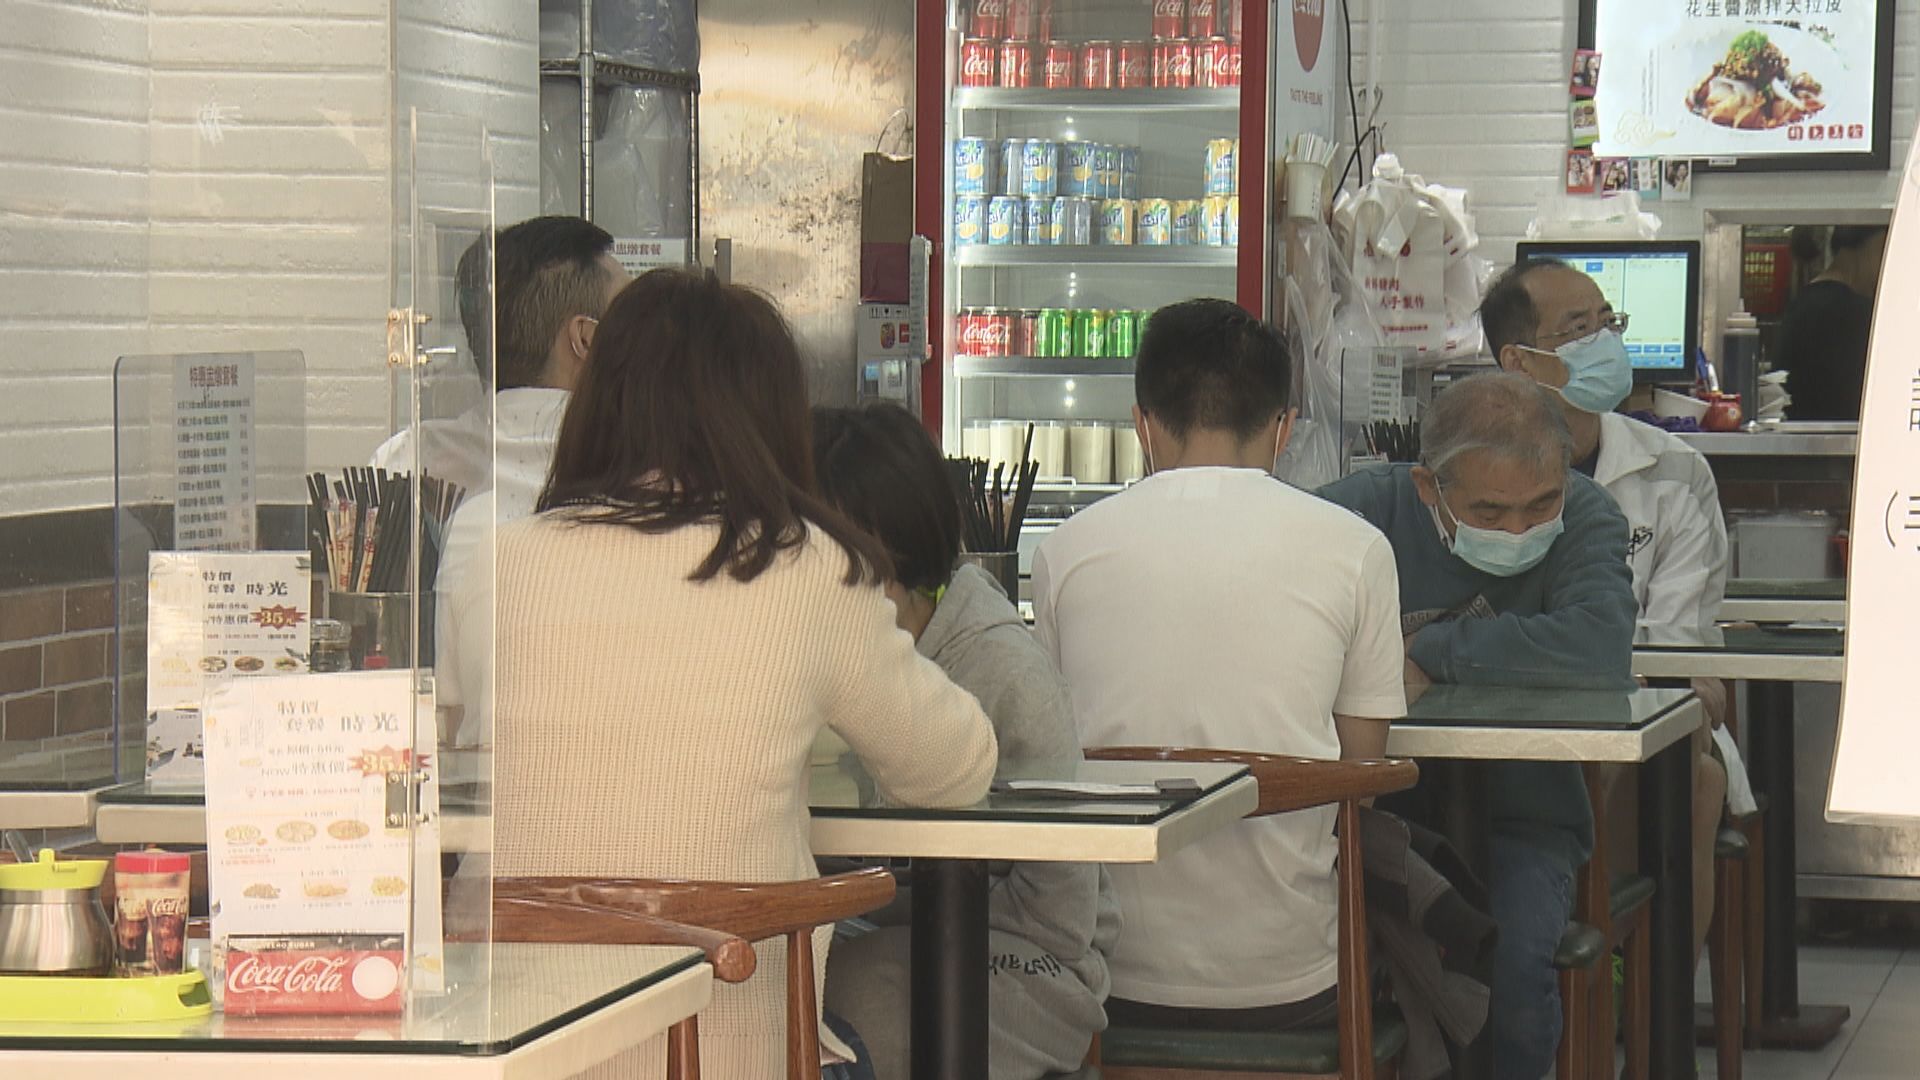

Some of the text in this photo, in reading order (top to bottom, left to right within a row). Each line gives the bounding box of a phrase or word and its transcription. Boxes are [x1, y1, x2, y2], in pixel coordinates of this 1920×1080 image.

[246, 580, 288, 596] 時光
[340, 712, 399, 732] 時光
[228, 956, 348, 994] Coca-Cola
